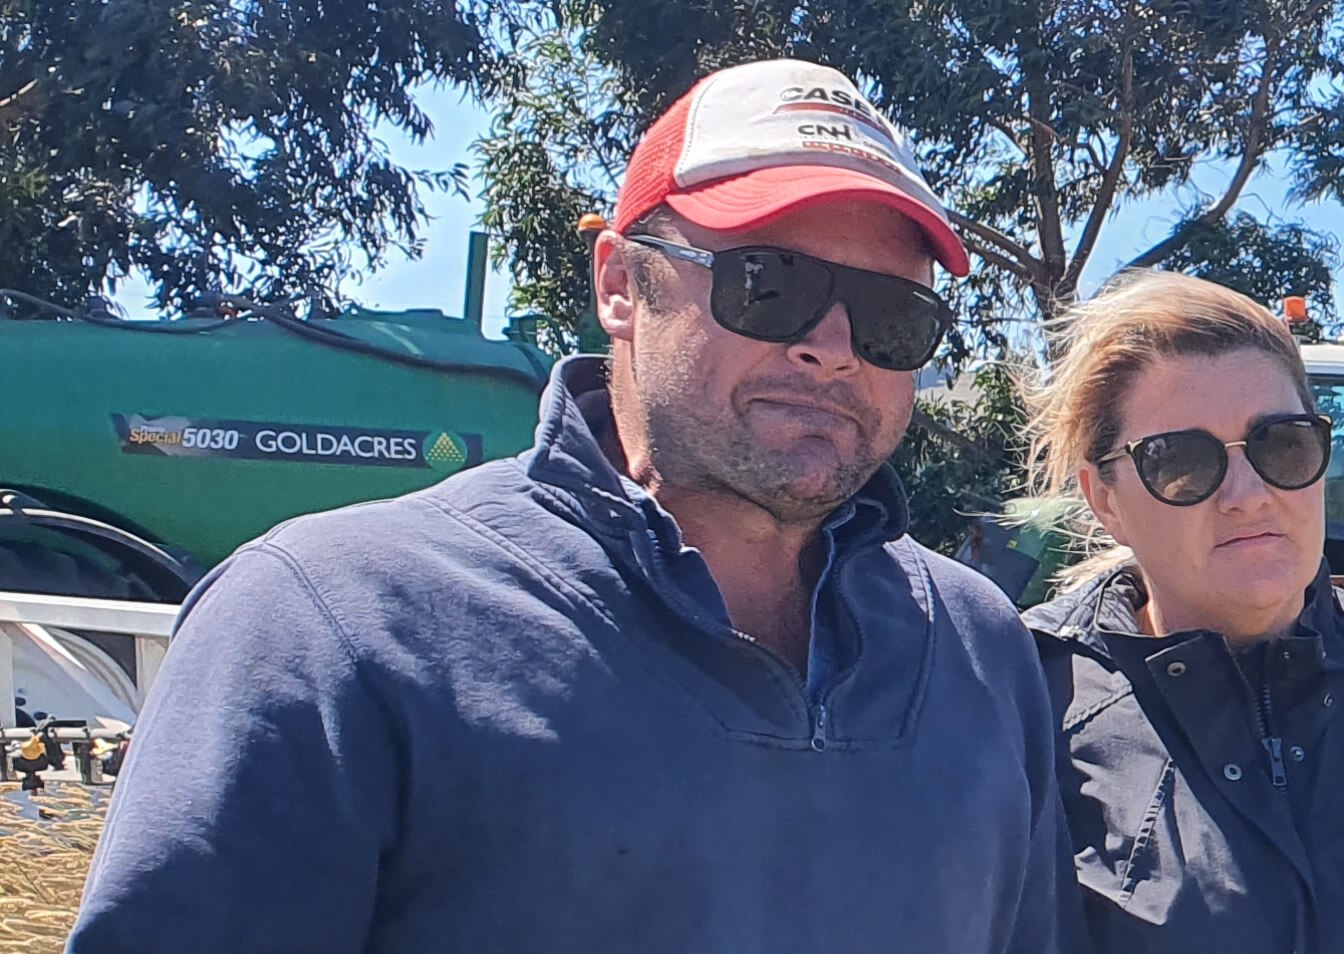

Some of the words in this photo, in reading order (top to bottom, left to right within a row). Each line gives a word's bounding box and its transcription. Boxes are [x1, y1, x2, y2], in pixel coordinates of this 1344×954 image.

[780, 87, 873, 117] CASE
[798, 124, 852, 141] CNH
[181, 428, 239, 450] 5030
[255, 430, 417, 460] GOLDACRES
